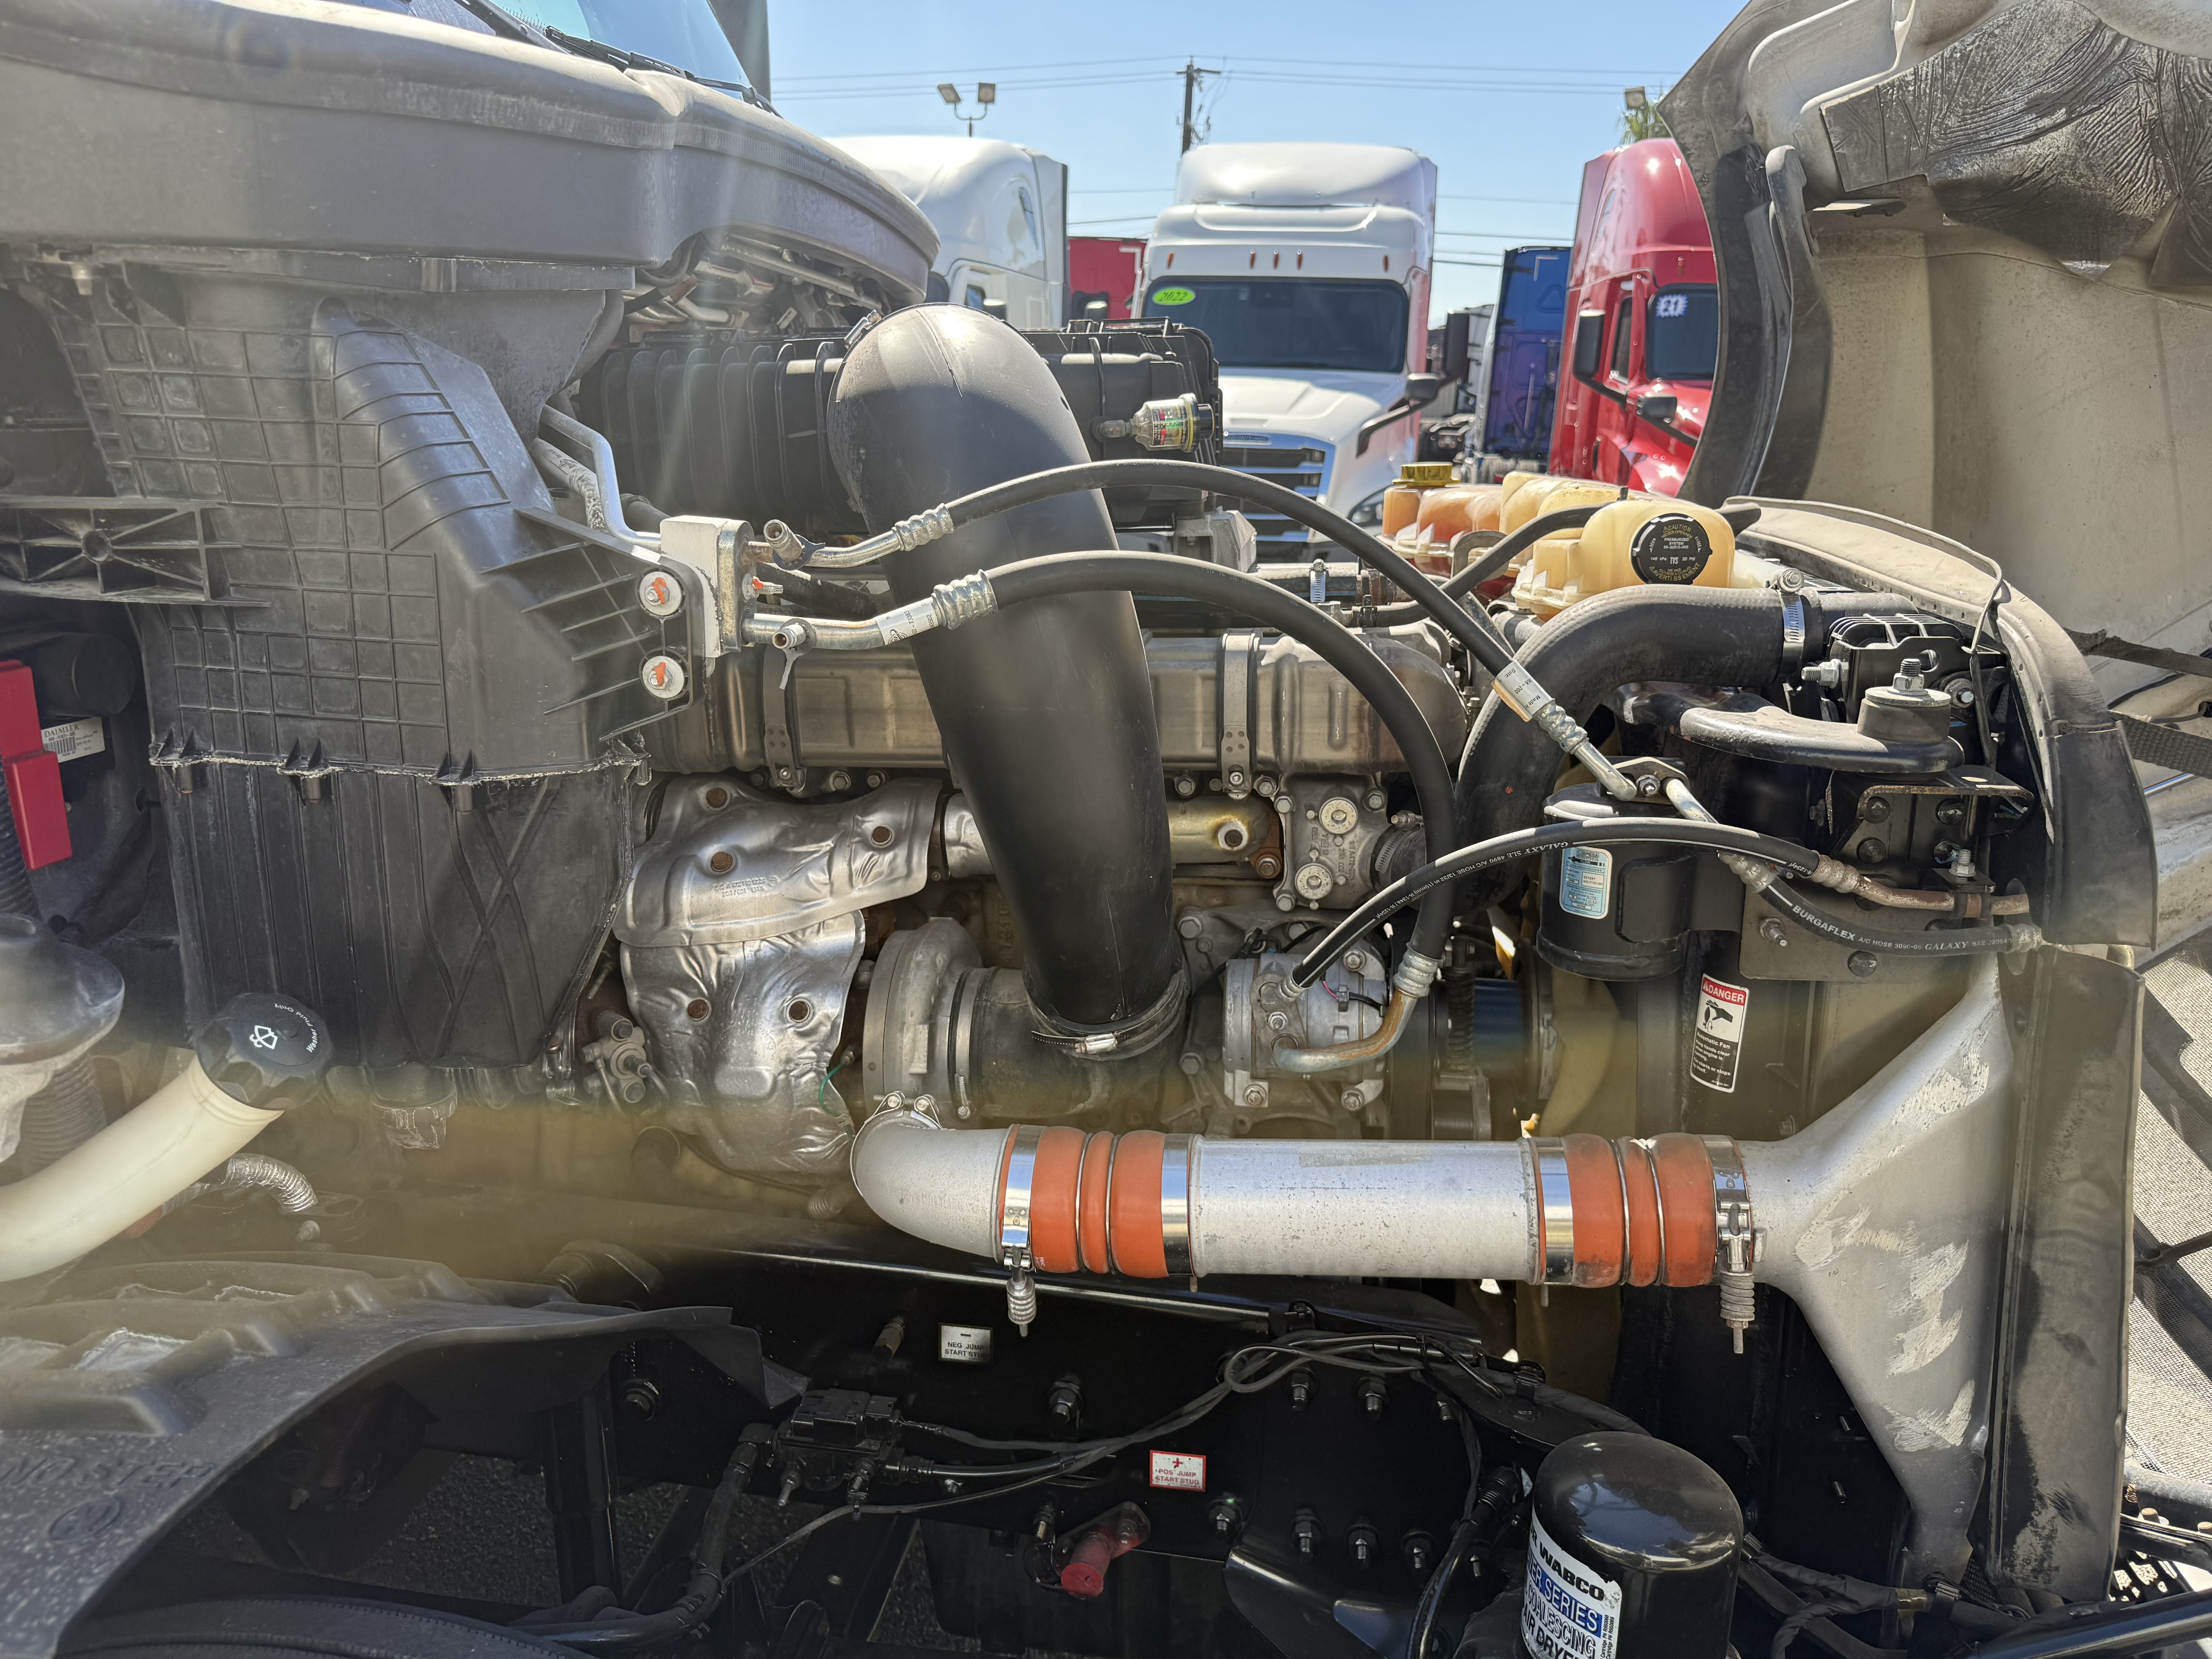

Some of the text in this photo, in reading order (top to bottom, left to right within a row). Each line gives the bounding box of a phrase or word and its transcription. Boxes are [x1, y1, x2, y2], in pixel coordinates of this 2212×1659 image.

[1158, 291, 1188, 302] 2022
[1668, 524, 1692, 532] CAUTION
[1652, 562, 1700, 581] AVERTISSEMENT
[1528, 695, 1541, 706] Made
[44, 724, 81, 738] DAIMLER
[1525, 842, 1568, 854] GALAXY
[1476, 860, 1487, 868] A/C
[1489, 855, 1504, 863] 4890
[1788, 863, 1814, 875] R-1234yf
[1439, 872, 1456, 882] 13/32
[1397, 892, 1415, 904] R-134a
[1792, 904, 1856, 941] BURGAFLEX
[1872, 939, 1893, 948] HOSE
[1925, 941, 1968, 951] GALAXY
[1709, 985, 1745, 1003] DANGER
[275, 1003, 318, 1053] Washer Fluid Only
[1697, 1031, 1719, 1046] Automatic
[1703, 1049, 1717, 1058] engine
[1704, 1044, 1717, 1053] hands
[1699, 1061, 1711, 1070] starts
[945, 1348, 967, 1357] START
[74, 1461, 216, 1491] STEP
[1539, 1540, 1605, 1602] WABCO
[1544, 1578, 1598, 1635] SERIES
[1523, 1603, 1535, 1637] AIR
[1528, 1581, 1596, 1659] COALESCING
